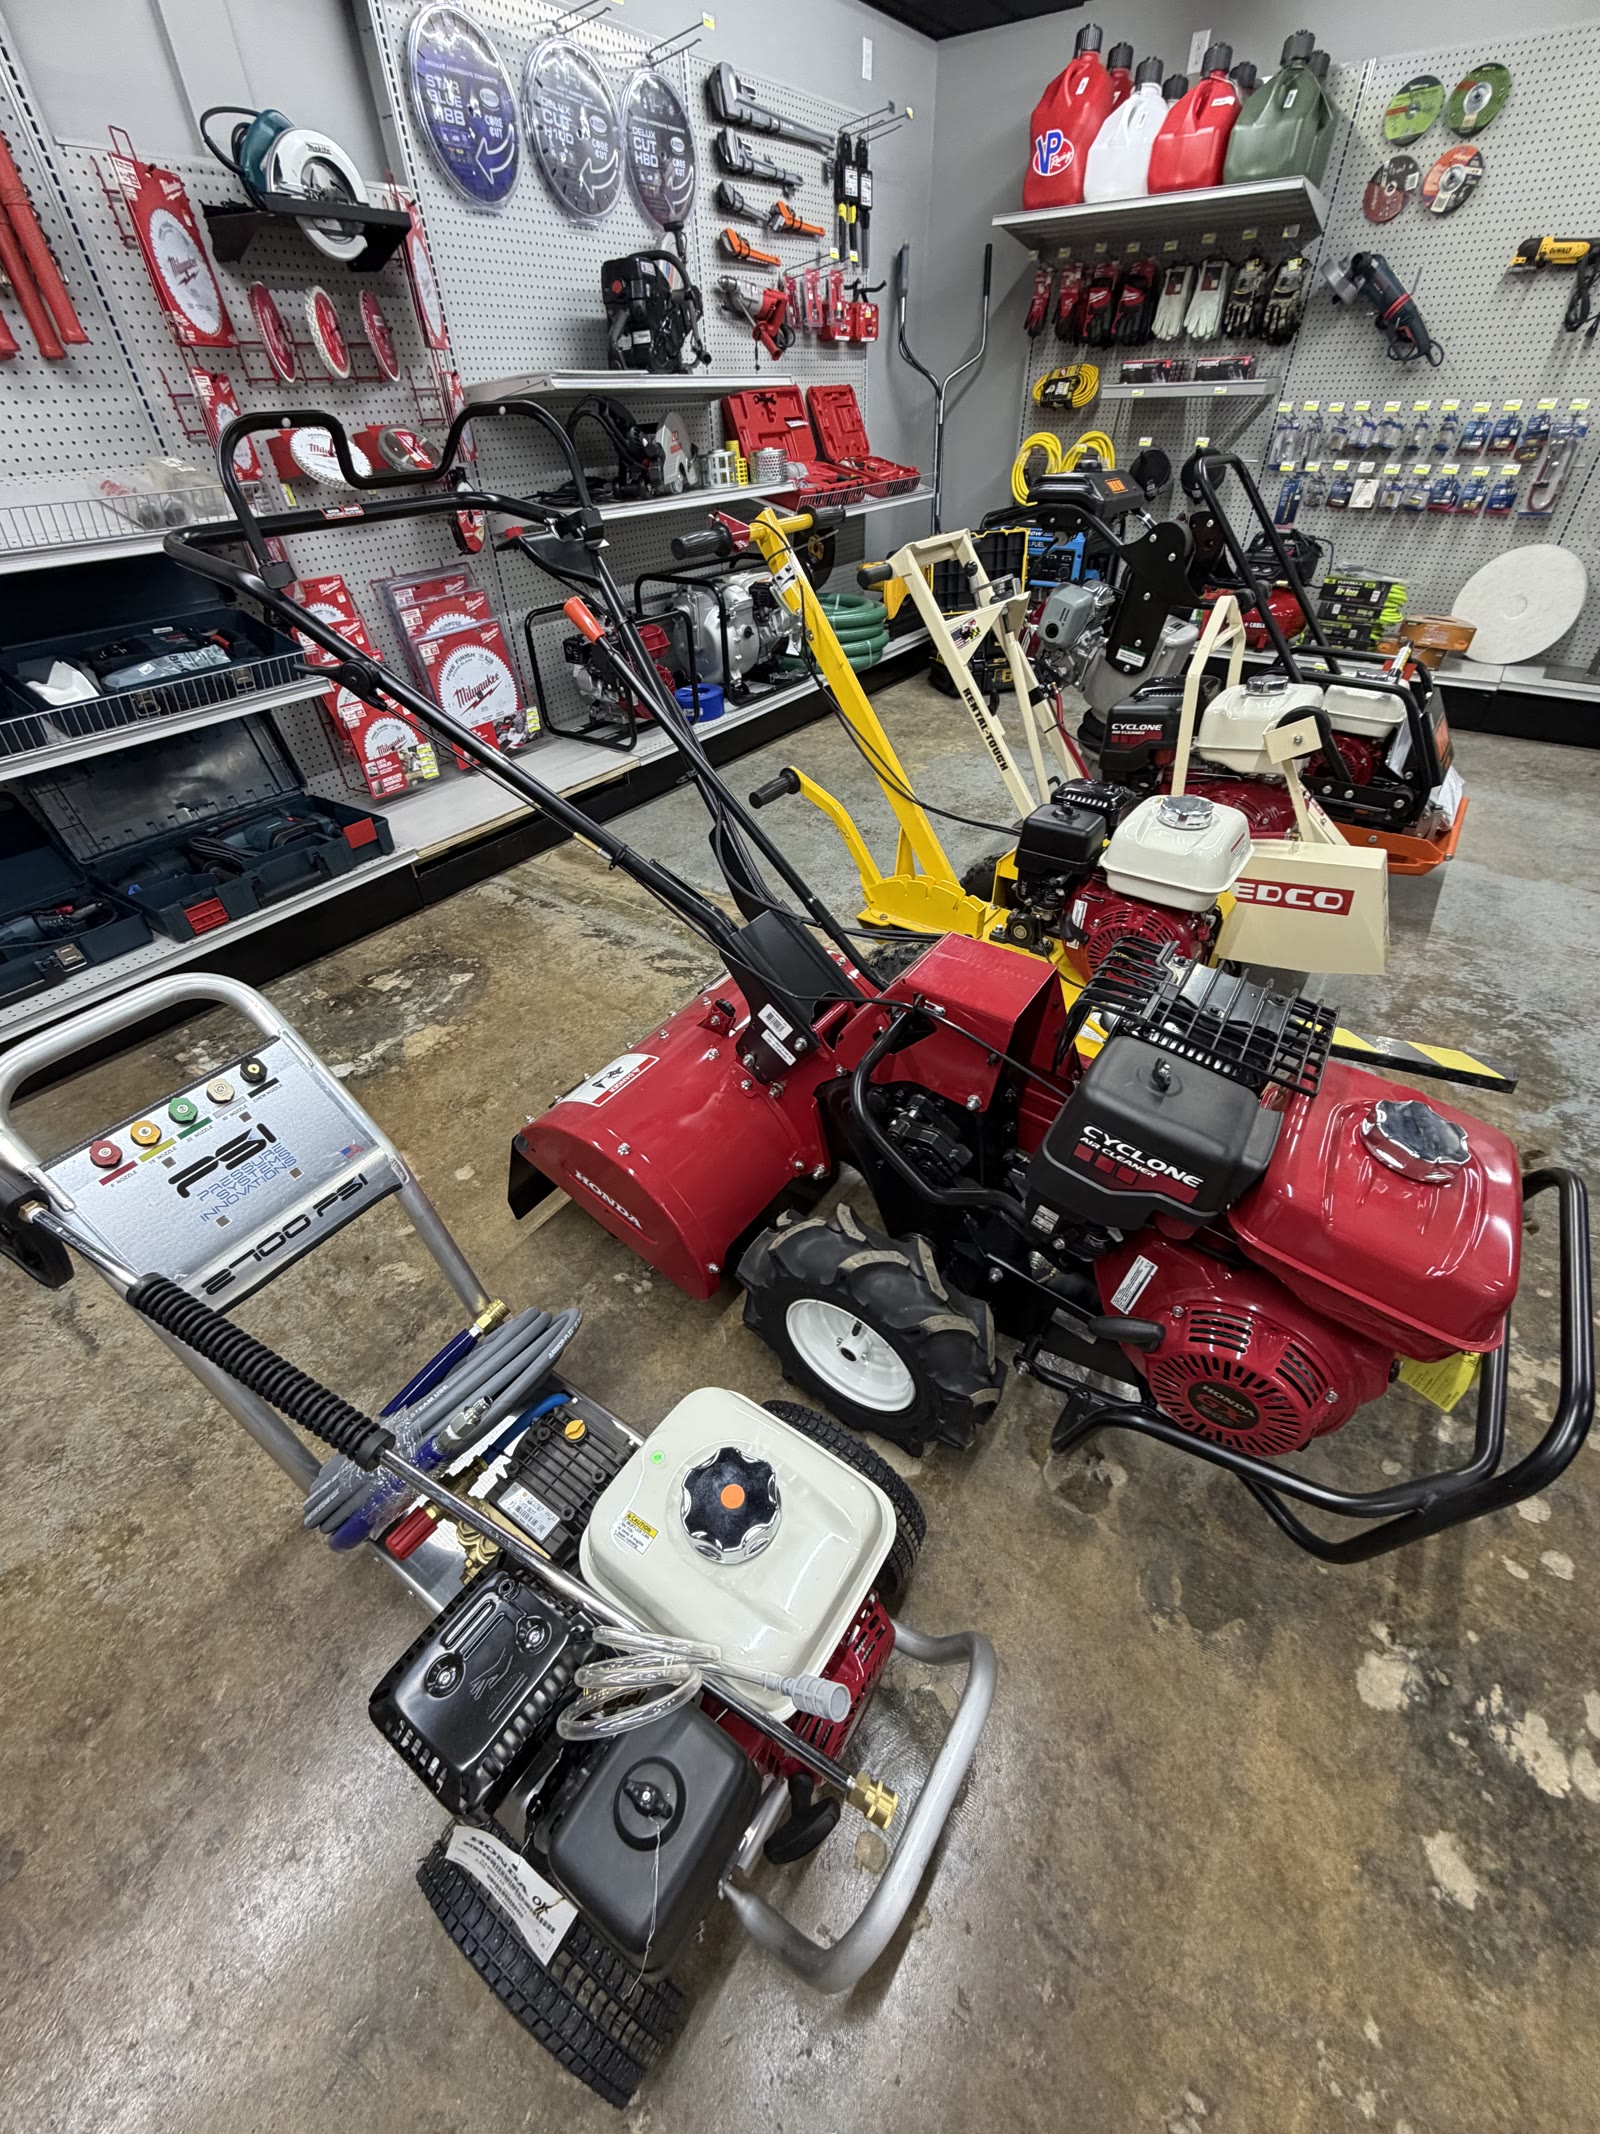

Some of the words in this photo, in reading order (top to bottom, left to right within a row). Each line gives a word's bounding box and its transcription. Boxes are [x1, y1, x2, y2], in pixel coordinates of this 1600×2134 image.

[425, 74, 460, 94] STAR
[542, 108, 572, 131] CUT
[632, 126, 656, 140] DELUX
[633, 136, 657, 154] CUT
[635, 150, 659, 168] H8D
[1036, 129, 1062, 174] VP
[1050, 150, 1074, 169] Racing
[446, 663, 456, 681] FINE
[455, 652, 476, 665] FINISH
[453, 672, 500, 708] Milwaukee
[962, 687, 1009, 771] RENTAL-TOUGH
[1111, 723, 1163, 731] CYCLONE
[376, 734, 406, 757] Milwaukee
[1234, 881, 1344, 910] EDCO
[253, 1094, 266, 1103] CHEM
[265, 1083, 283, 1096] NOZZLE
[229, 1105, 249, 1118] NOZZLE
[194, 1125, 214, 1138] NOZZLE
[157, 1147, 177, 1160] NOZZLE
[168, 1123, 277, 1198] PSI
[1079, 1137, 1101, 1150] AIR
[1101, 1148, 1158, 1178] CLEANER
[1083, 1125, 1204, 1188] CYCLONE
[116, 1171, 138, 1184] NOZZLE
[197, 1142, 281, 1201] PRESSURE
[217, 1148, 290, 1201] SYSTEMS
[200, 1158, 297, 1222] INNOVATIONS
[575, 1170, 643, 1230] HONDA
[201, 1214, 311, 1295] 2700
[312, 1173, 369, 1217] PSI
[409, 1396, 434, 1418] STEAM
[434, 1384, 449, 1398] USE
[1201, 1384, 1256, 1417] HONDA
[631, 1515, 653, 1533] CAUTION
[470, 1836, 529, 1896] HONDA
